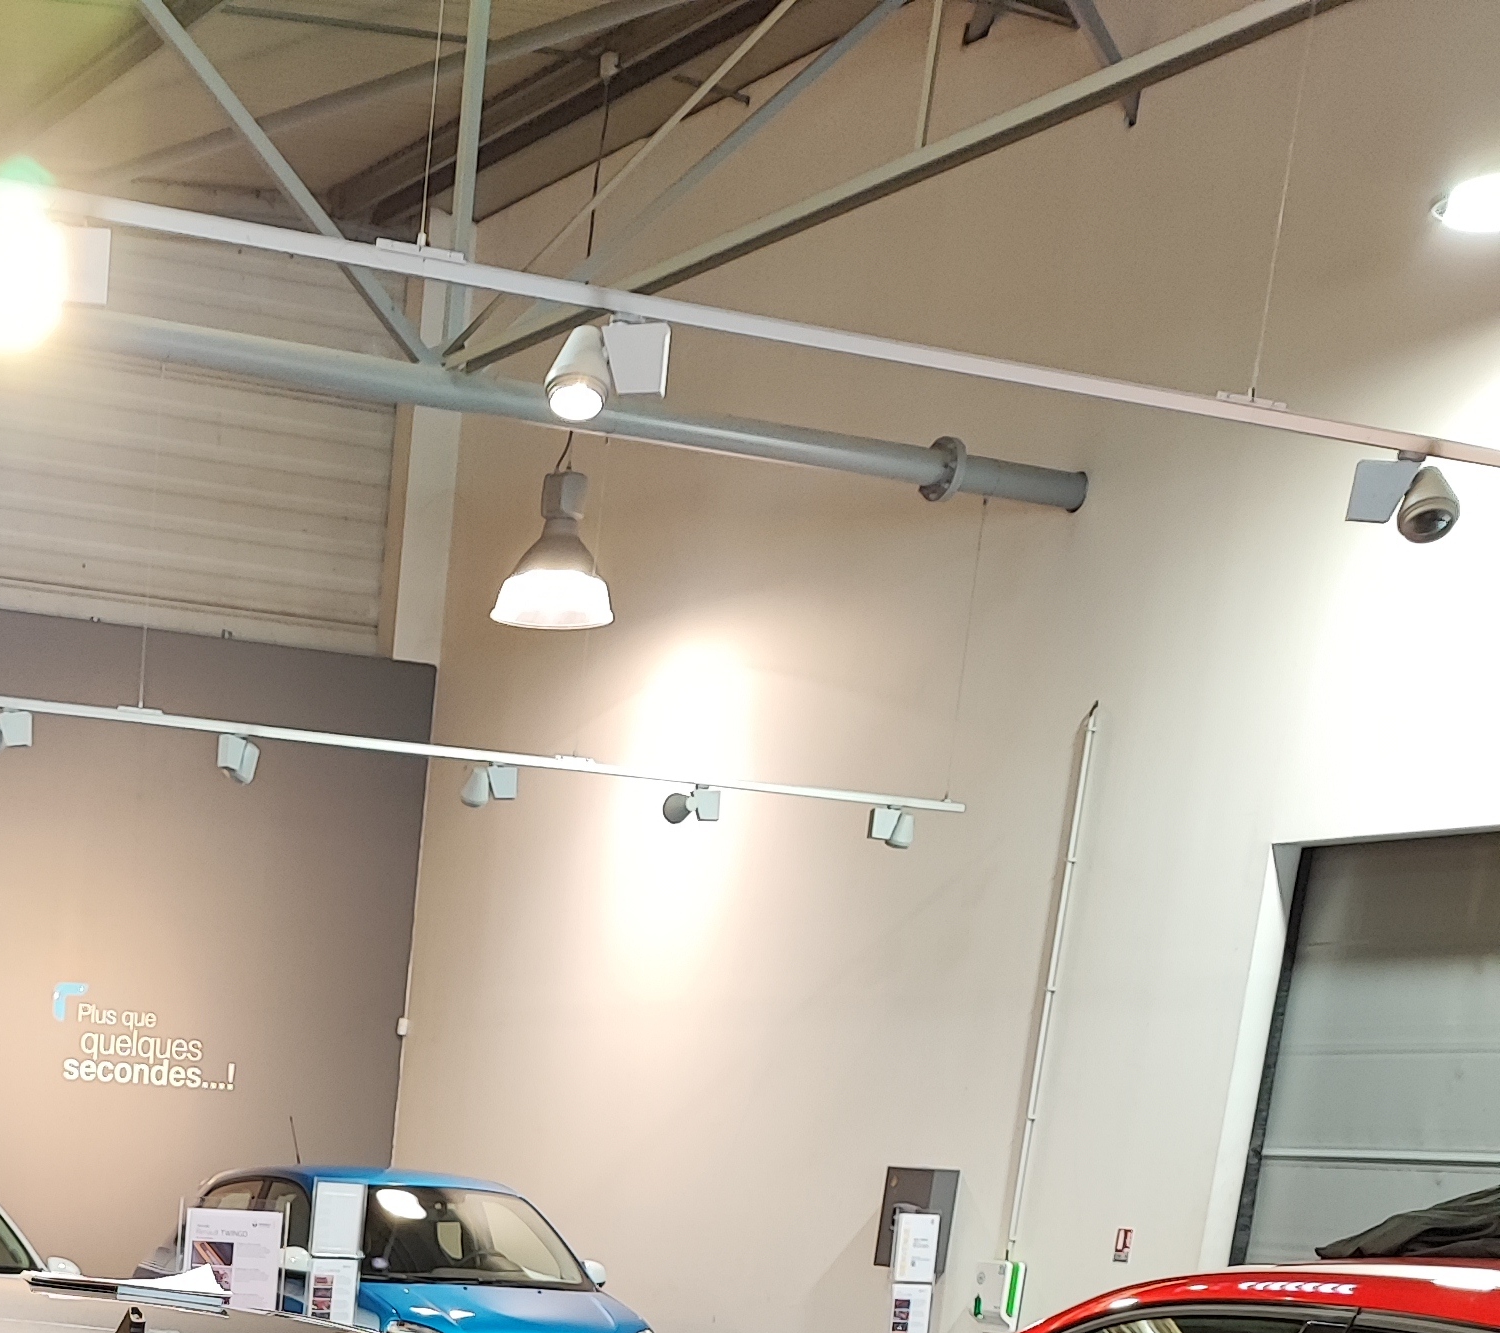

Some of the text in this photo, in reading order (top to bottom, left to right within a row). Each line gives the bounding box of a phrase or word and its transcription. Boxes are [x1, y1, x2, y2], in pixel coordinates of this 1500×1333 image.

[77, 1003, 157, 1031] Plus que
[80, 1029, 203, 1064] quelques
